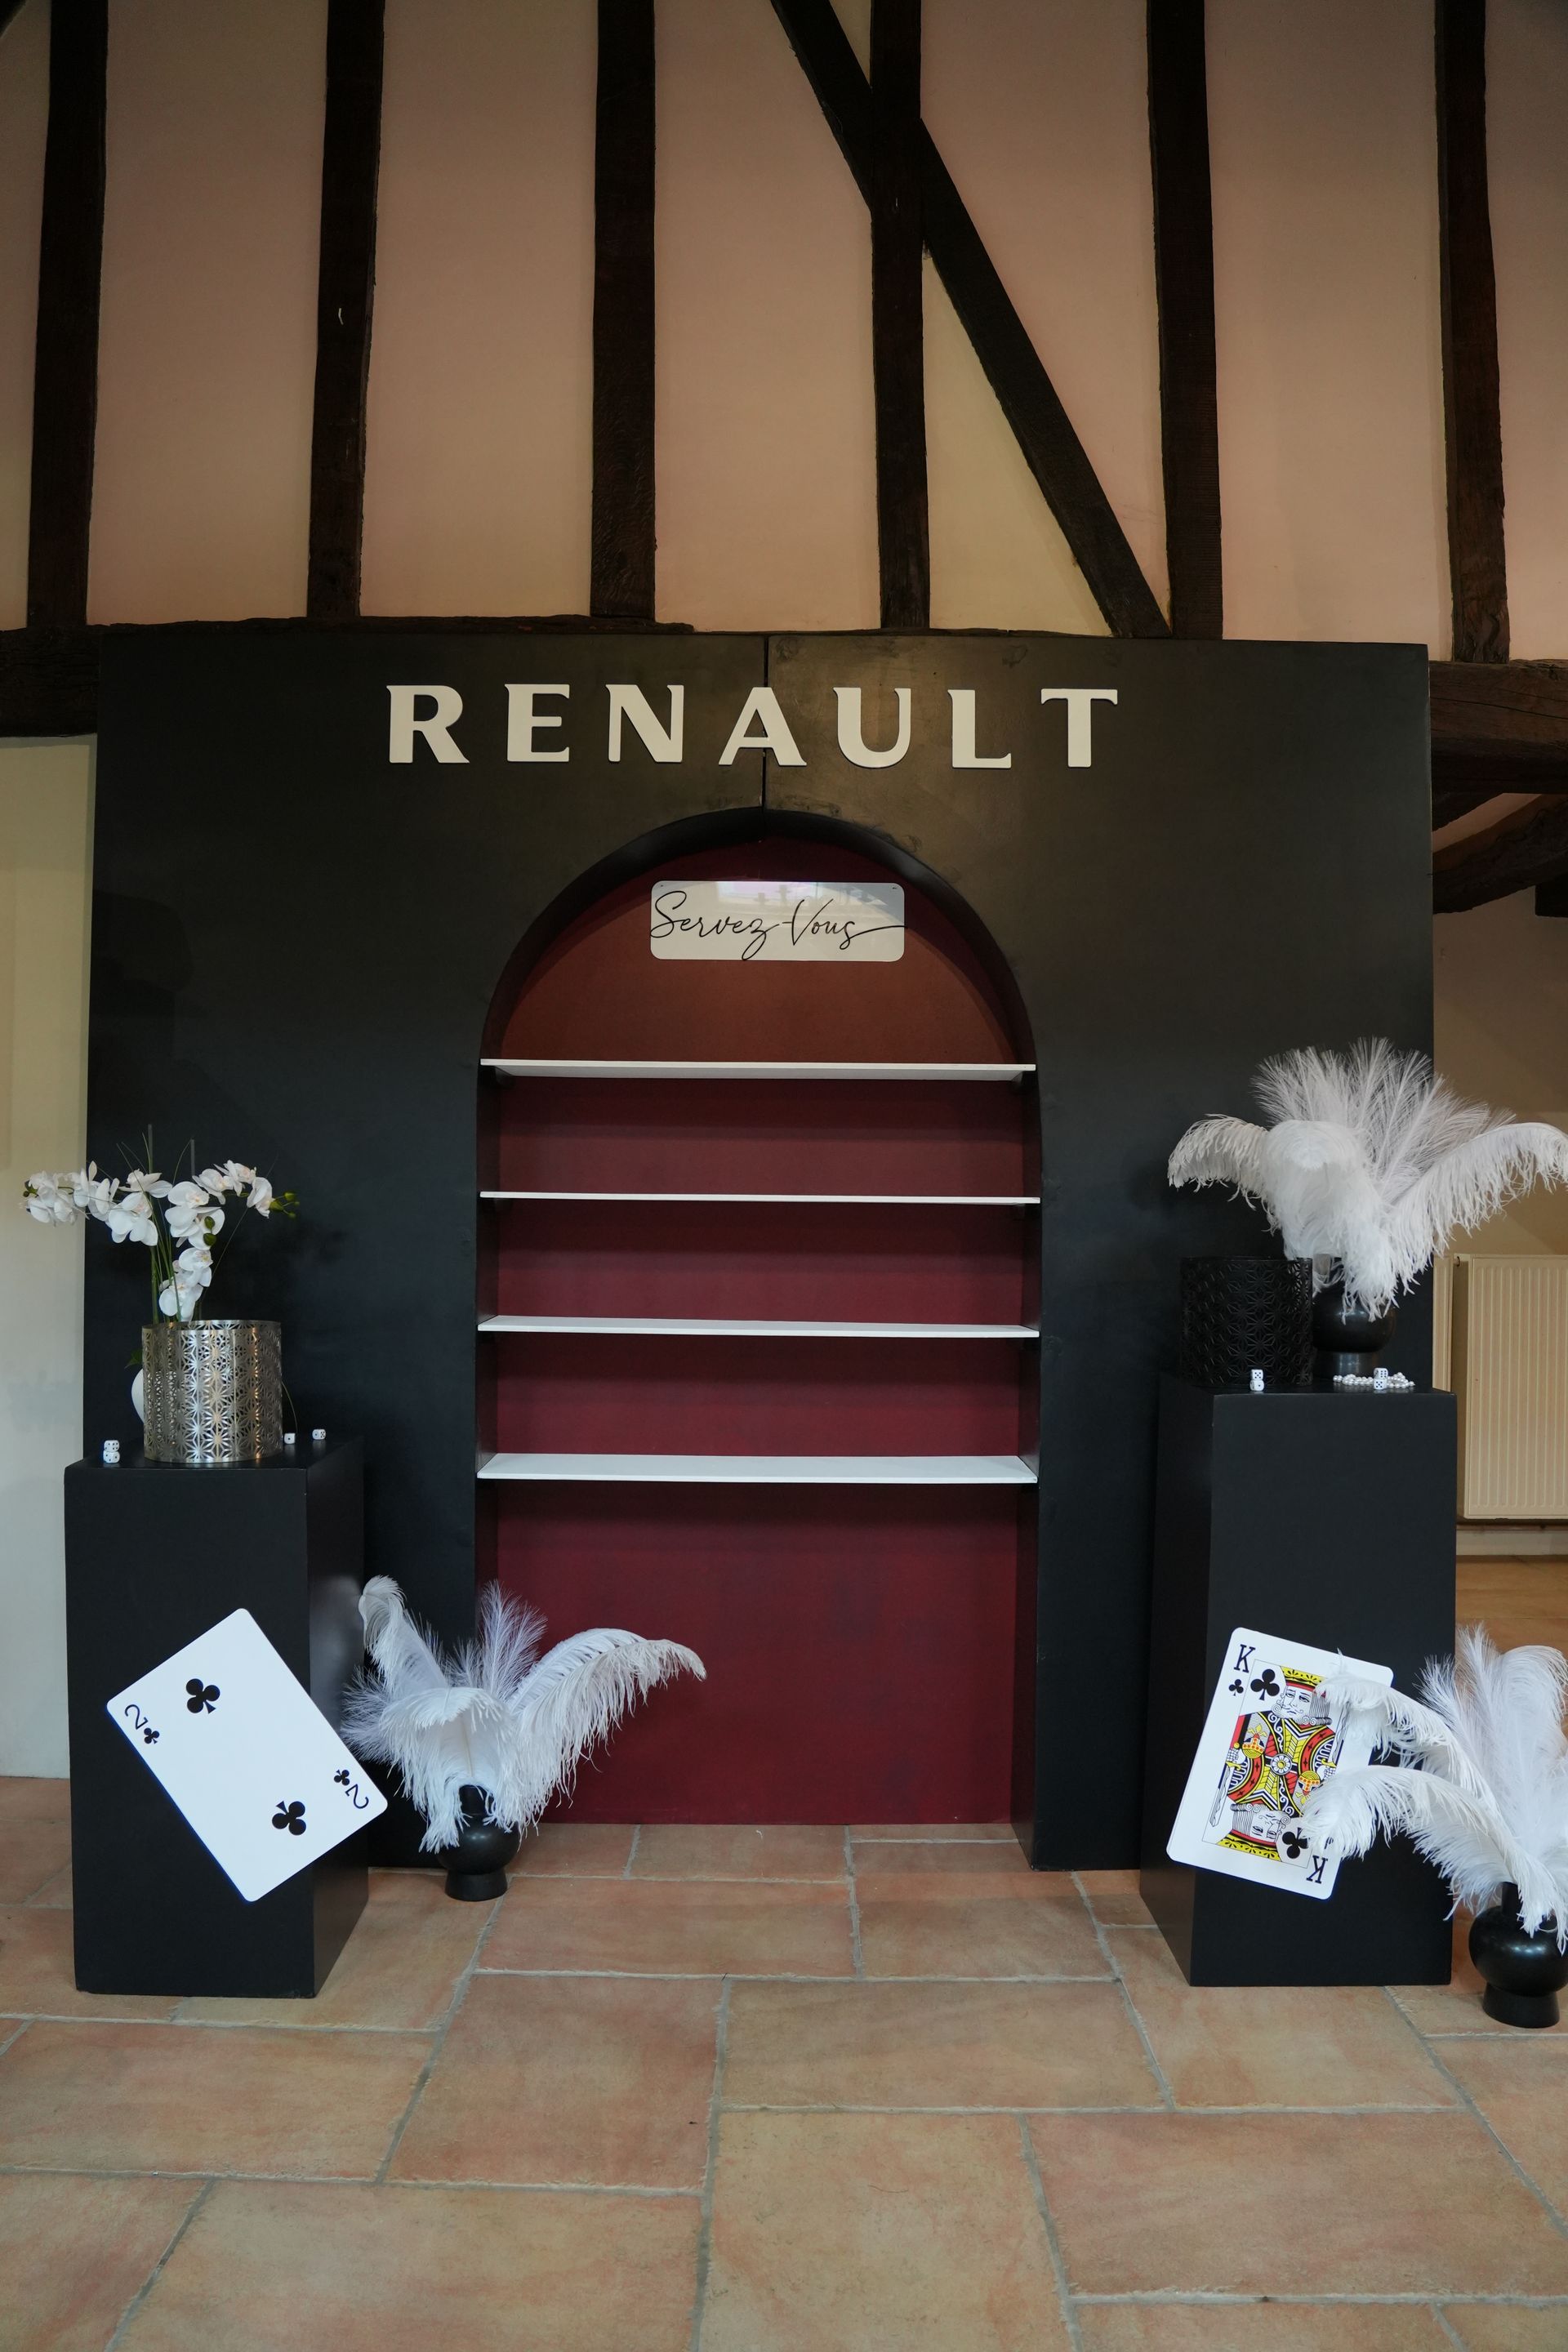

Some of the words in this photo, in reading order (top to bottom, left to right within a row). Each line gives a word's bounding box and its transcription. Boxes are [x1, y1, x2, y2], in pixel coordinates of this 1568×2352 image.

[387, 684, 1118, 768] RENAULT
[1234, 1644, 1256, 1673] K
[124, 1704, 149, 1730] 2
[345, 1784, 369, 1810] 2
[1306, 1855, 1329, 1884] K
